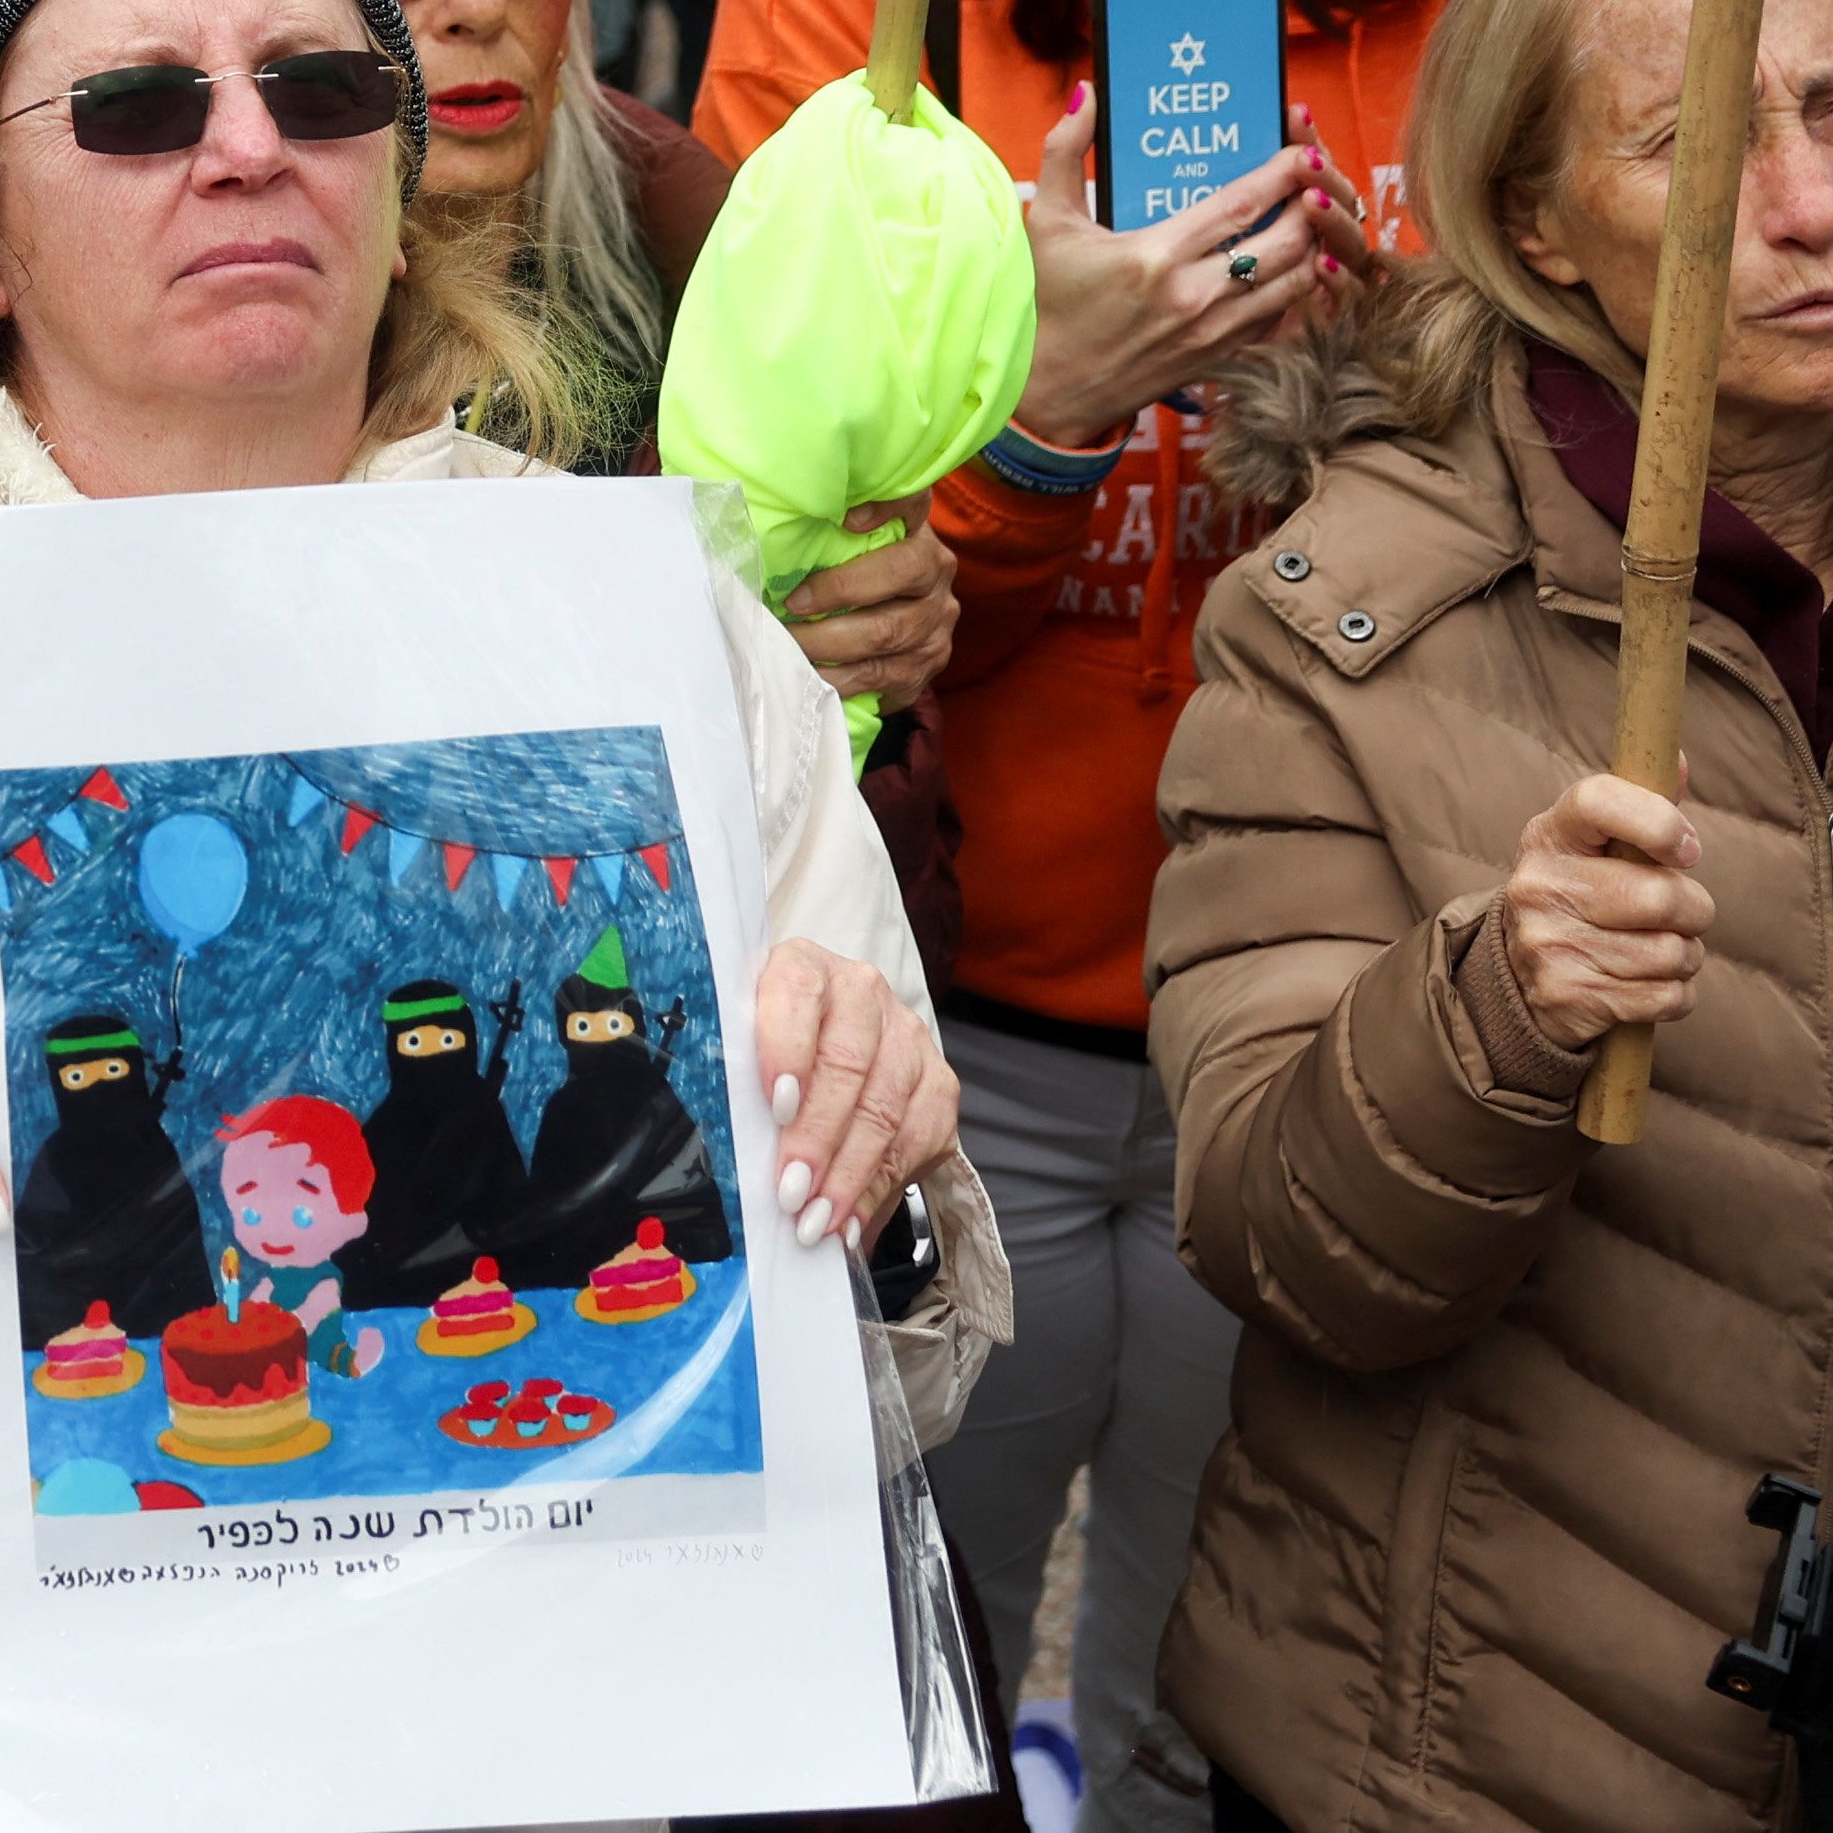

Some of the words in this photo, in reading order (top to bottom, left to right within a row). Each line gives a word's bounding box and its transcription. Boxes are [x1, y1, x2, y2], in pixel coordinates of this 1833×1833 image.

[1148, 80, 1231, 115] KEEP
[1140, 122, 1240, 158] CALM
[1173, 162, 1208, 178] AND
[1144, 183, 1224, 219] FUC
[197, 1509, 300, 1550] לכפיר
[313, 1510, 396, 1543] שנה
[412, 1498, 535, 1539] הולדת
[547, 1498, 596, 1530] יום
